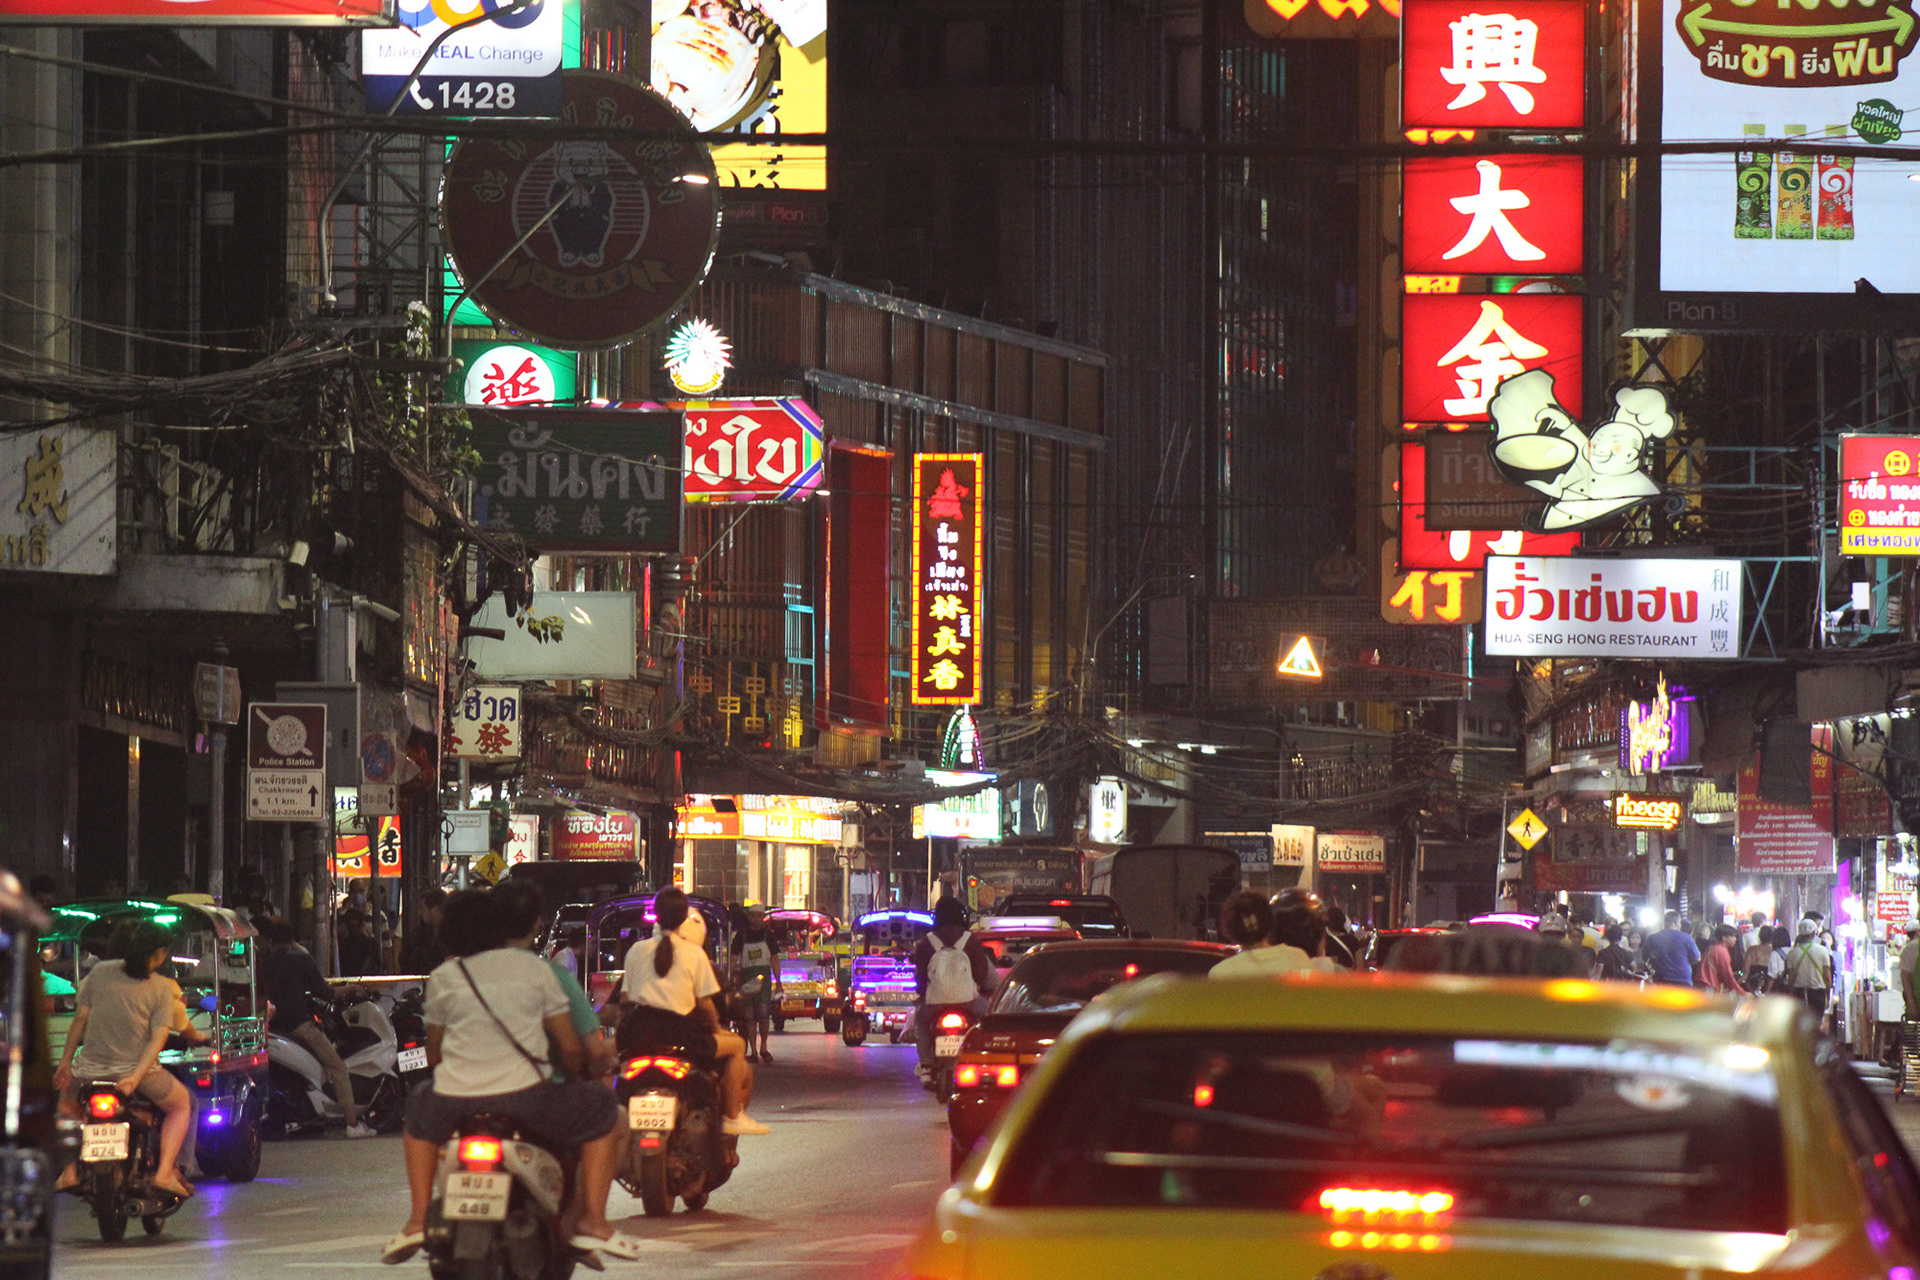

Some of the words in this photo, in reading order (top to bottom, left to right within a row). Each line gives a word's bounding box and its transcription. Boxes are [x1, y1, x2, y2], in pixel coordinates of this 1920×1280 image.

[379, 44, 422, 58] Make
[479, 45, 543, 64] Change
[438, 81, 515, 109] 1428
[1667, 301, 1715, 321] Plan
[685, 414, 798, 485] งใบ
[1495, 561, 1699, 623] ฮั่วเซ่งฮง
[1495, 633, 1522, 644] HUA
[1527, 633, 1563, 645] SENG
[1567, 634, 1606, 645] HONG
[1609, 634, 1698, 647] RESTAURANT
[259, 756, 284, 766] Police
[286, 757, 315, 766] Station
[258, 786, 303, 794] Chakkrawat
